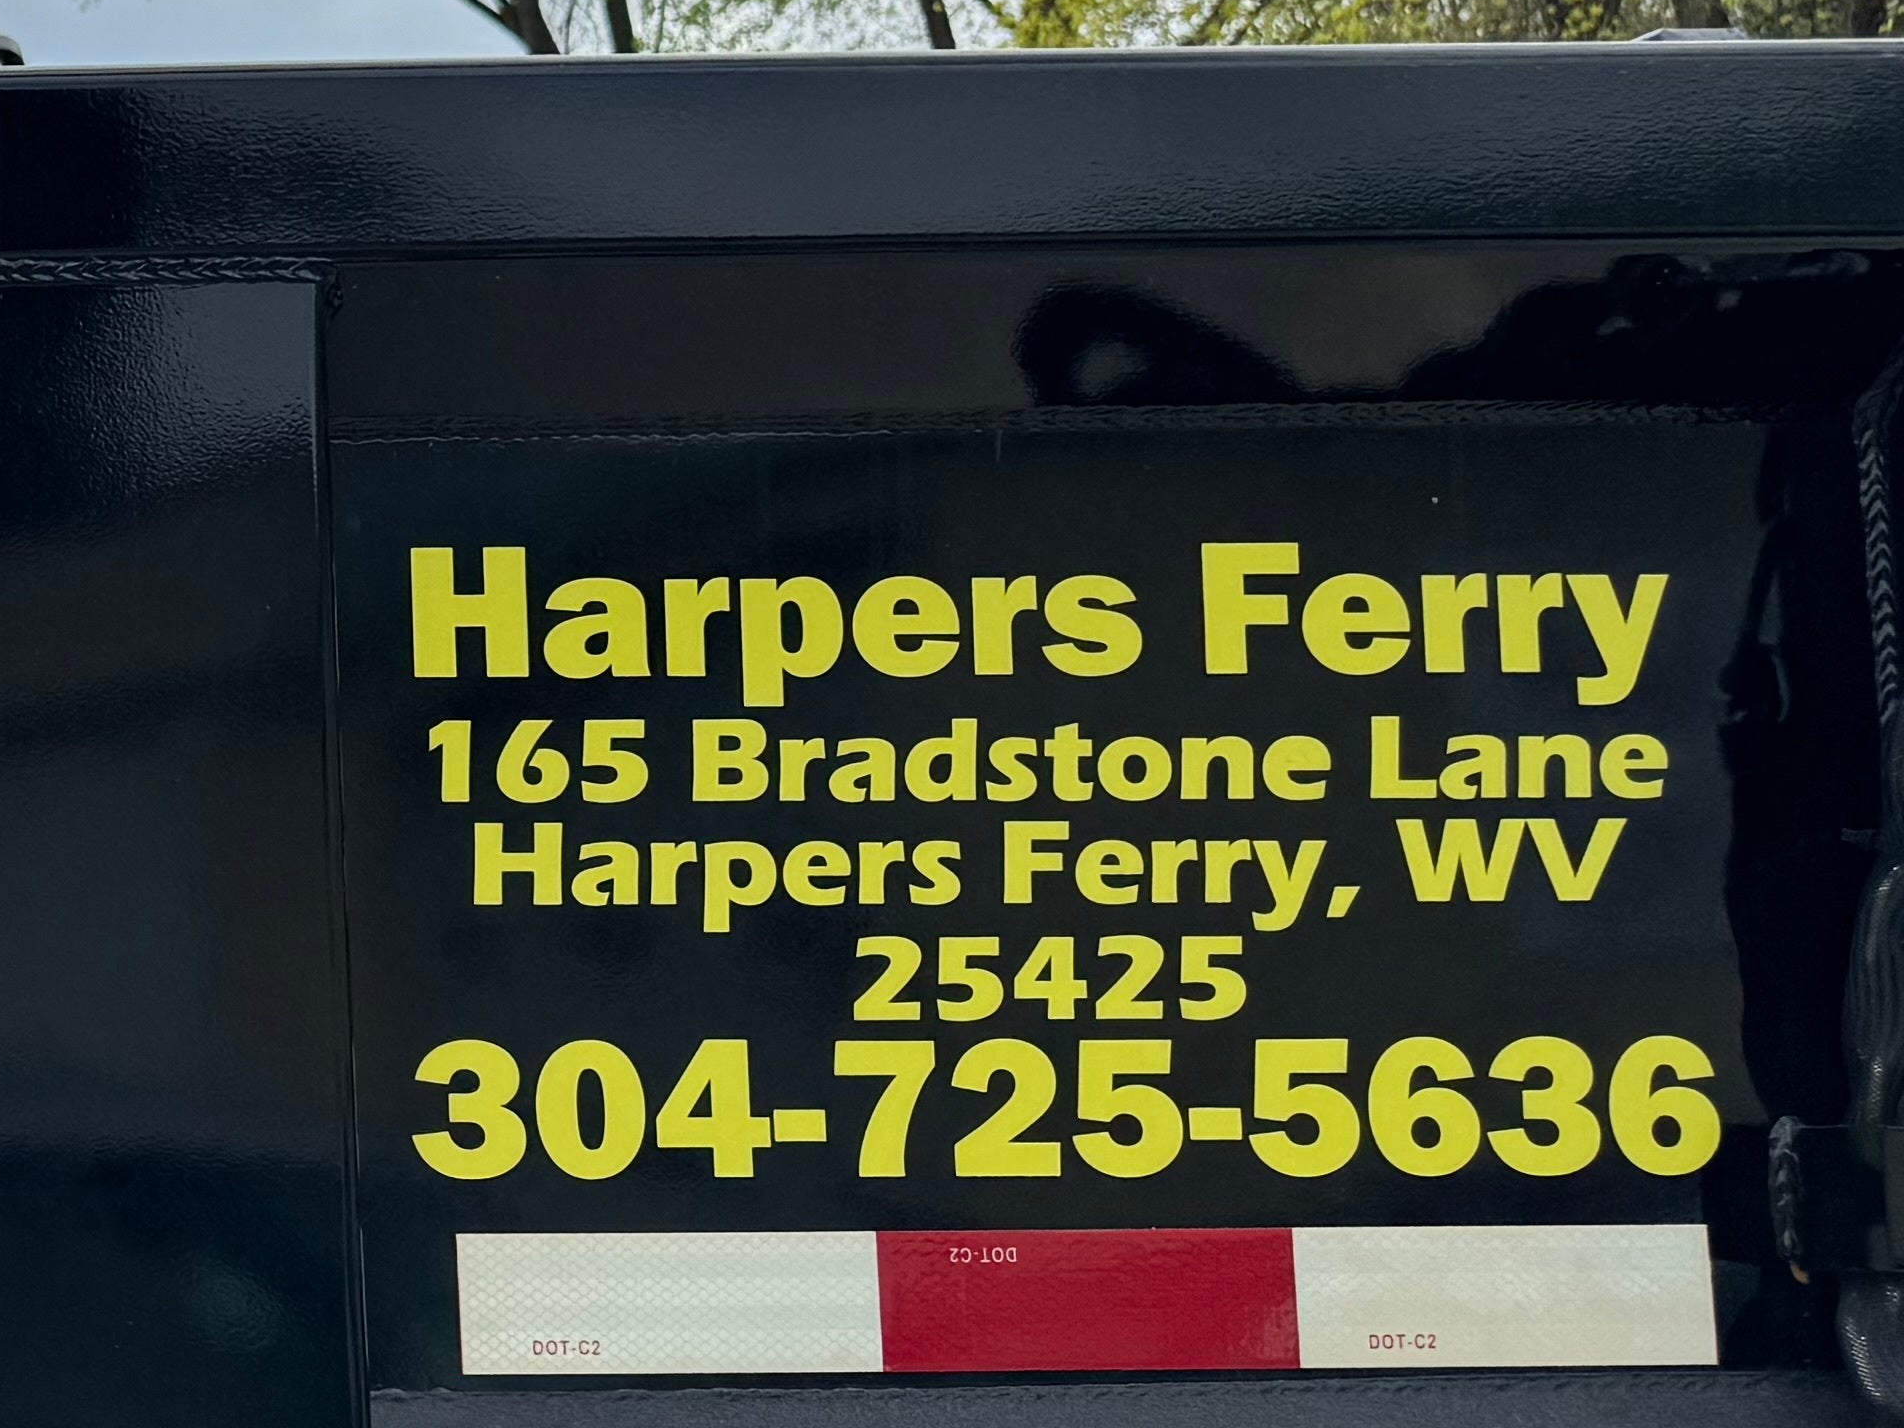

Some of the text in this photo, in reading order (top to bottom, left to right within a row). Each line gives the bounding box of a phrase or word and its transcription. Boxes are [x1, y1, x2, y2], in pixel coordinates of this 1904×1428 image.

[413, 544, 1668, 705] Harpers Ferry
[431, 718, 1668, 802] 165 Bradstone Lane
[476, 821, 1625, 931] Harpers Ferry, WV
[855, 937, 1246, 1021] 25425
[416, 1038, 1721, 1179] 304-725-5636
[948, 1245, 1018, 1265] DOT-C2
[532, 1338, 602, 1357] DOT-C2
[1368, 1333, 1438, 1352] DOT-C2
